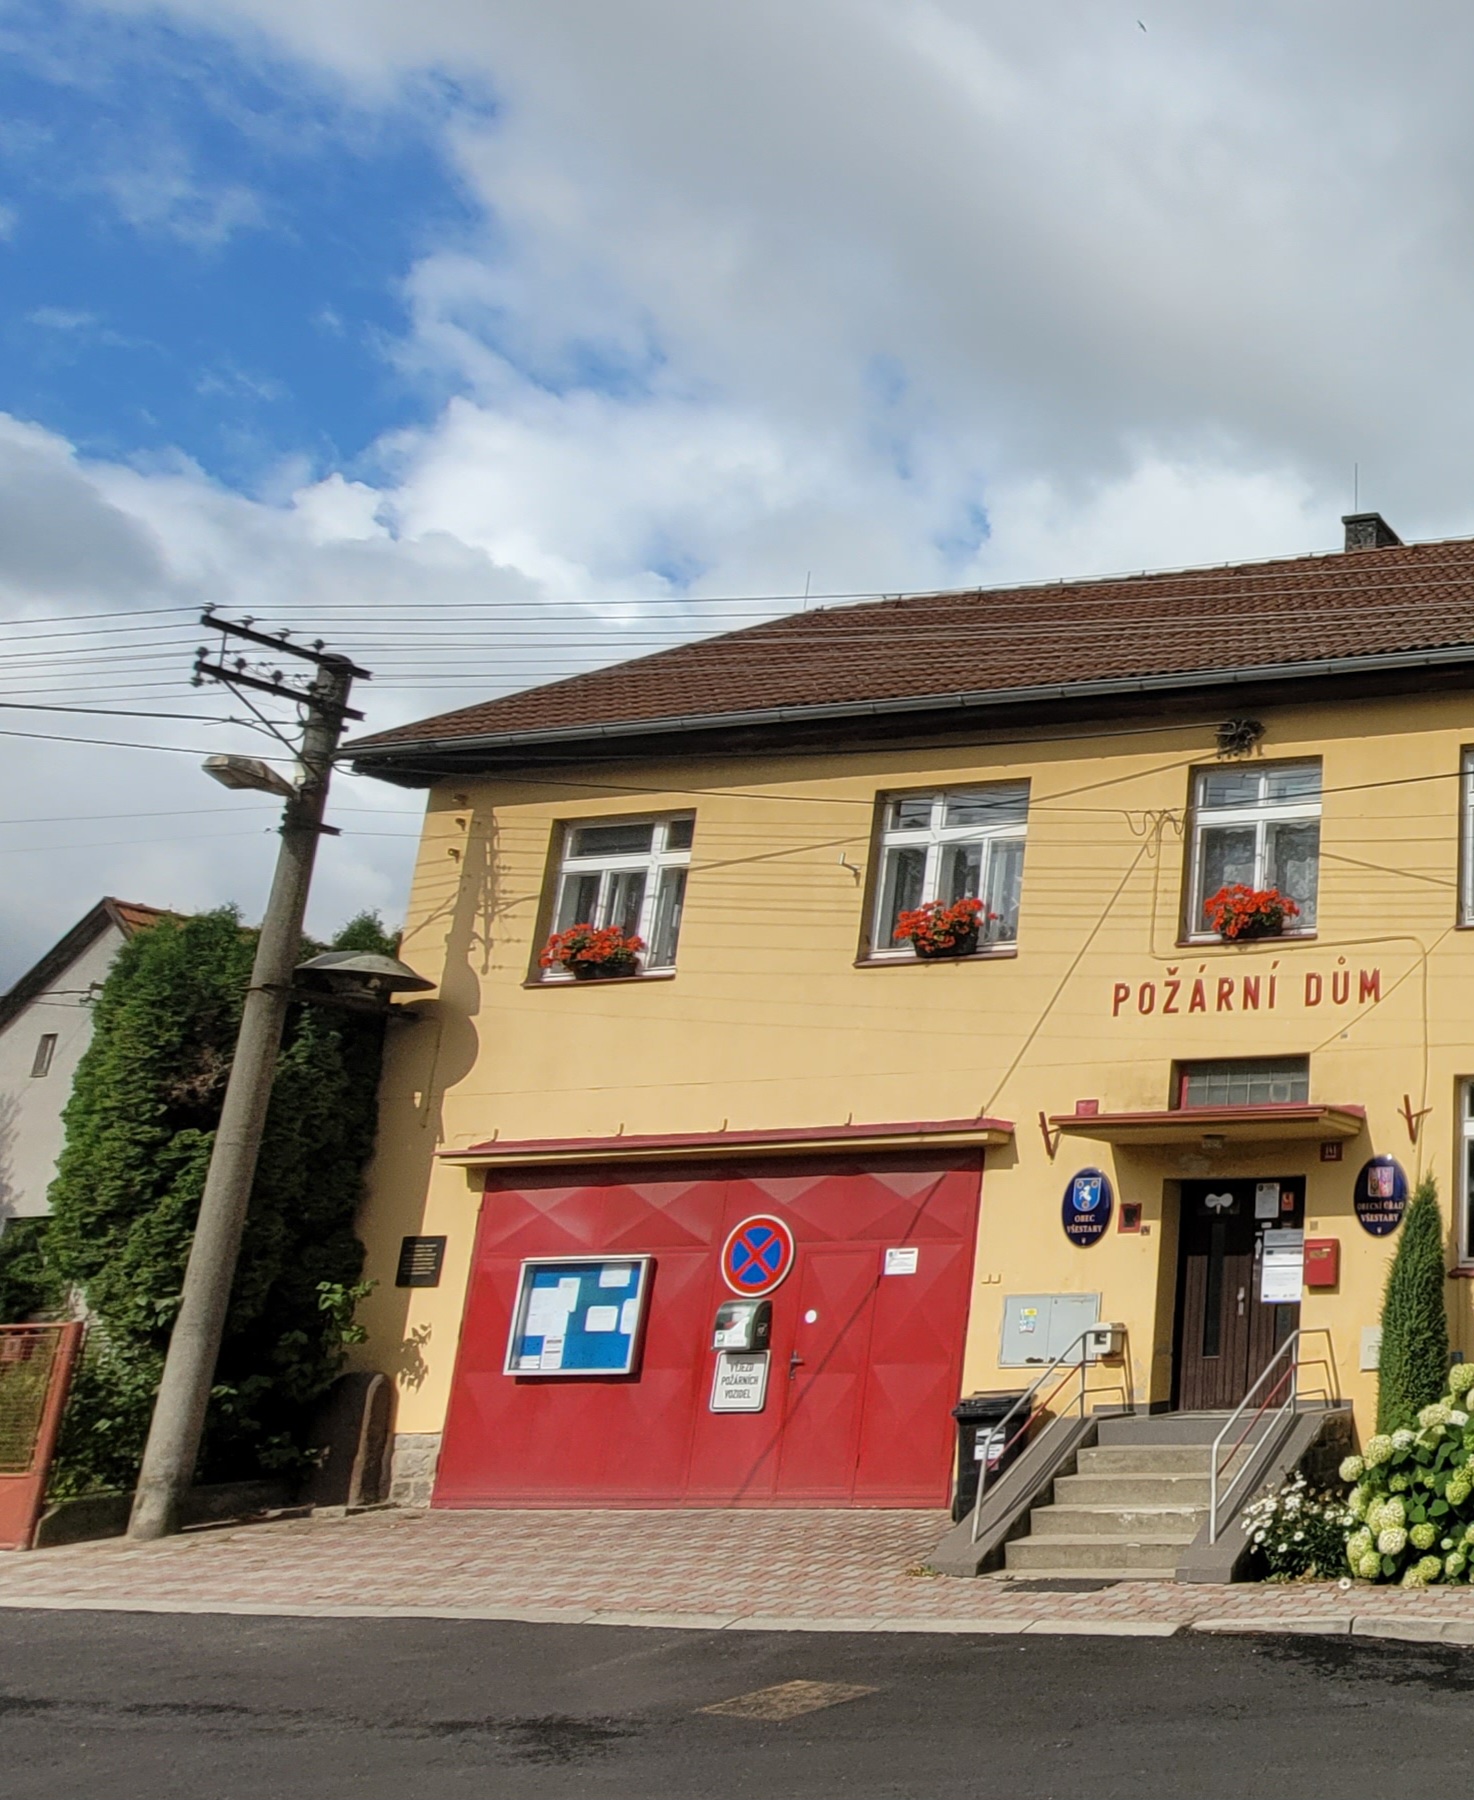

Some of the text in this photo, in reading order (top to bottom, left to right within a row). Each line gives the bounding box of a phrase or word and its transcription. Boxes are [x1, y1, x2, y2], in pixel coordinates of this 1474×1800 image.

[1112, 956, 1380, 1017] POŽÁRNÍ DŮM
[1357, 1201, 1382, 1210] OBECNÍ
[1074, 1214, 1095, 1222] OBEC
[1360, 1213, 1398, 1222] VŠESTARY
[1066, 1224, 1102, 1233] VŠESTARY
[721, 1374, 759, 1386] POŽÁRNÍCH
[724, 1389, 752, 1399] VOZIDEL
